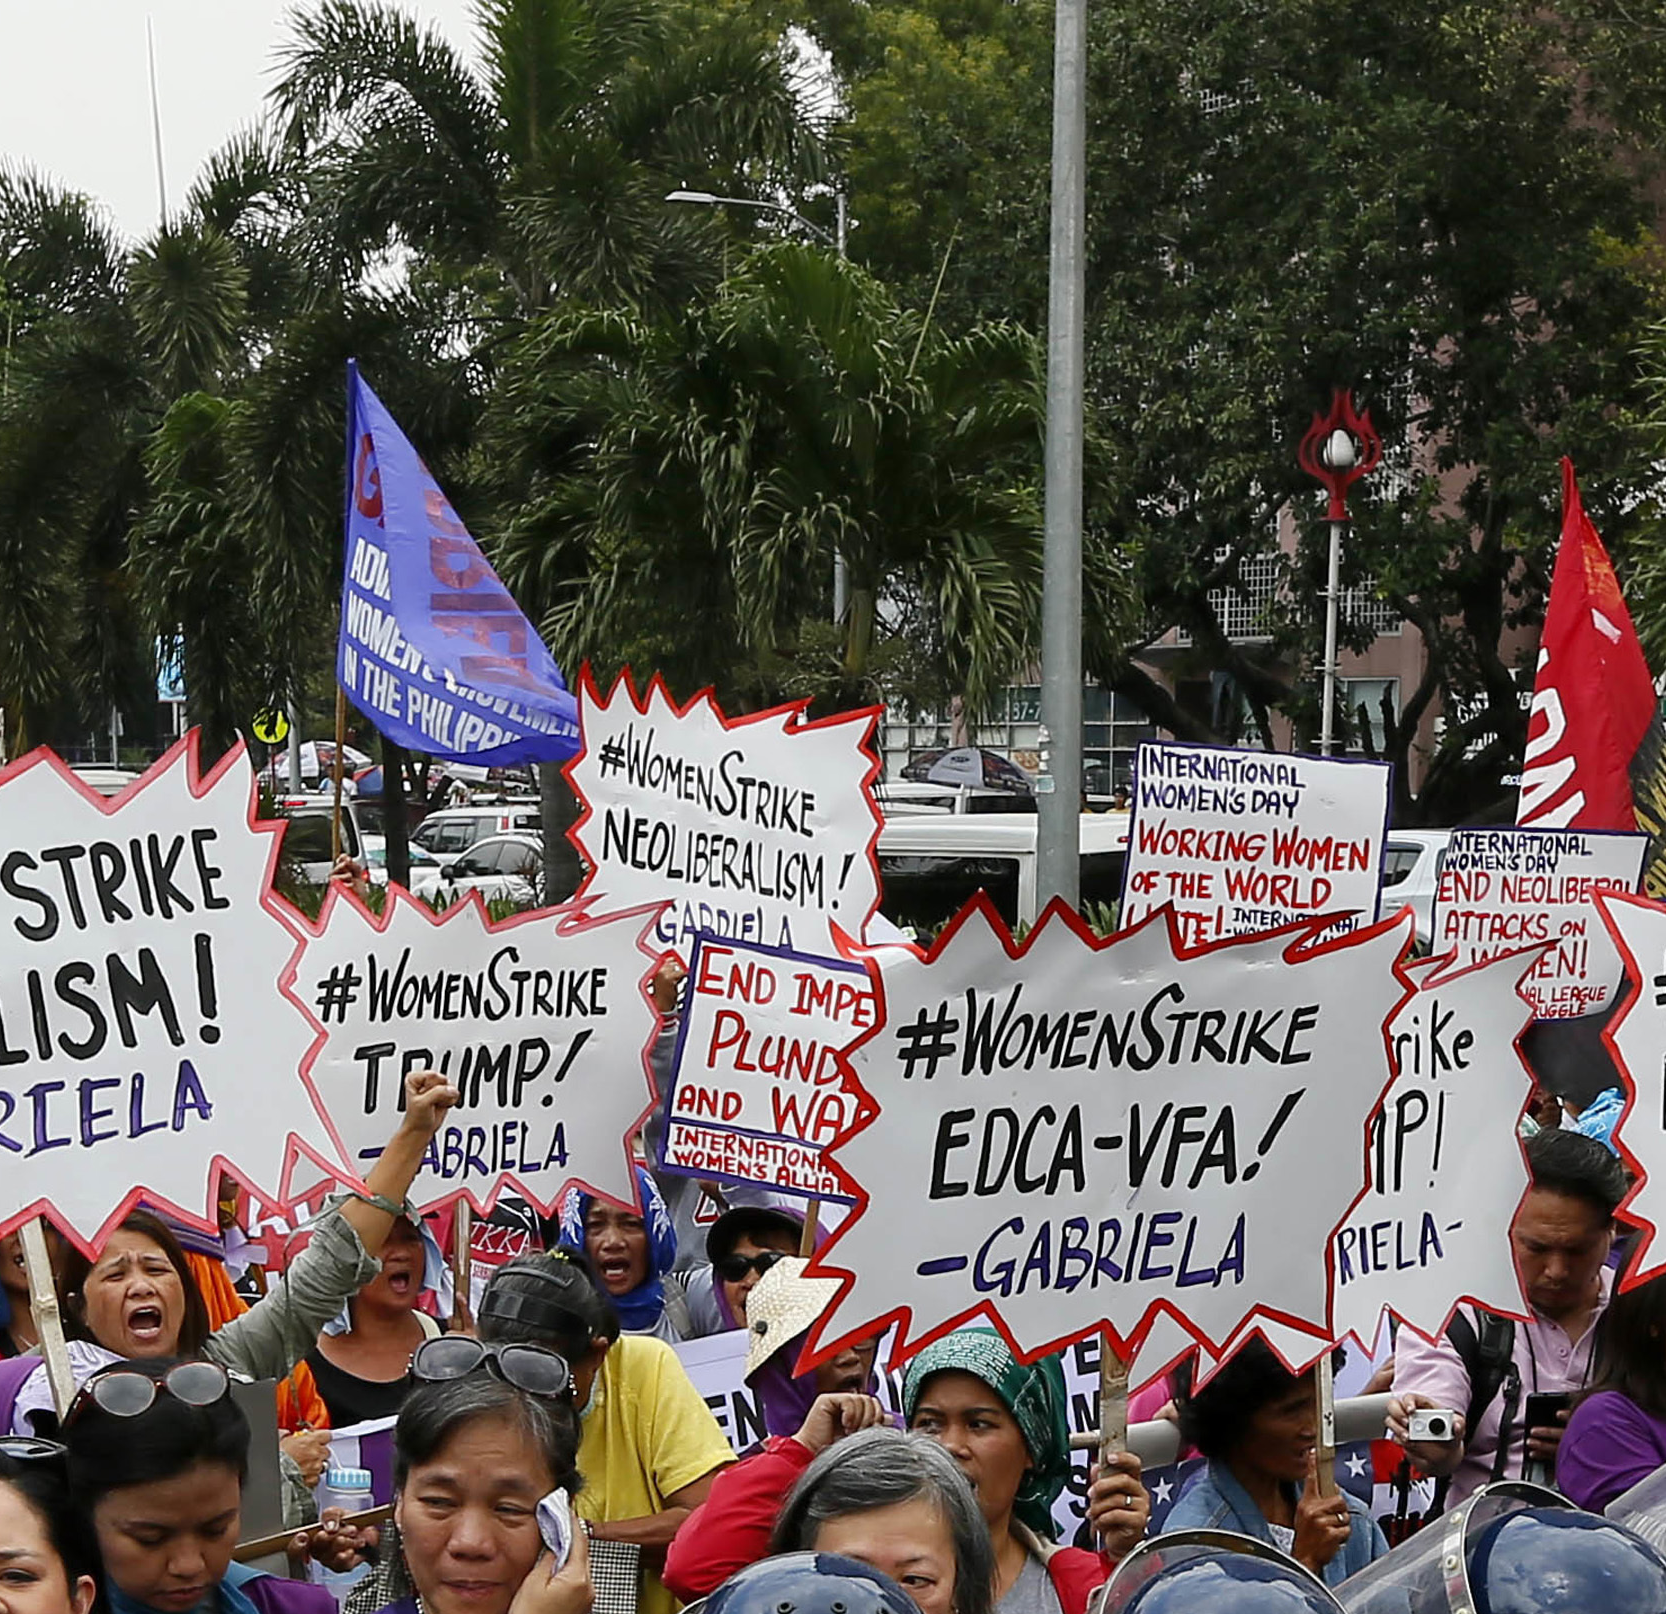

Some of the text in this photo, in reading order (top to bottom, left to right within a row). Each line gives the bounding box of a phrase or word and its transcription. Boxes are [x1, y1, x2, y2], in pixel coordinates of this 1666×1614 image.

[343, 643, 358, 691] IN
[362, 658, 402, 718] THE
[598, 722, 815, 838] #WOMENSTRIKE
[1141, 746, 1306, 788] INTERNATIONAL
[1141, 781, 1299, 819] WOMEN'S DAY
[1139, 818, 1370, 873] WORKING WOMEN
[1444, 853, 1559, 874] WOMEN'S DAY
[1130, 866, 1332, 910] OF THE WORLD
[1437, 870, 1492, 903] END
[1444, 910, 1587, 941] ATTACKS ON
[314, 946, 608, 1024] #WOMENSTRIKE
[695, 945, 875, 1028] END IMPE
[1550, 984, 1609, 1002] LEAGUE
[706, 1009, 843, 1086] PLUND
[896, 982, 1320, 1081] #WOMENSTRIKE
[676, 1083, 846, 1142] AND WA
[358, 1120, 570, 1181] -ABRIELA
[672, 1149, 768, 1180] WOMEN'S
[928, 1087, 1306, 1201] EDCA-VFA!
